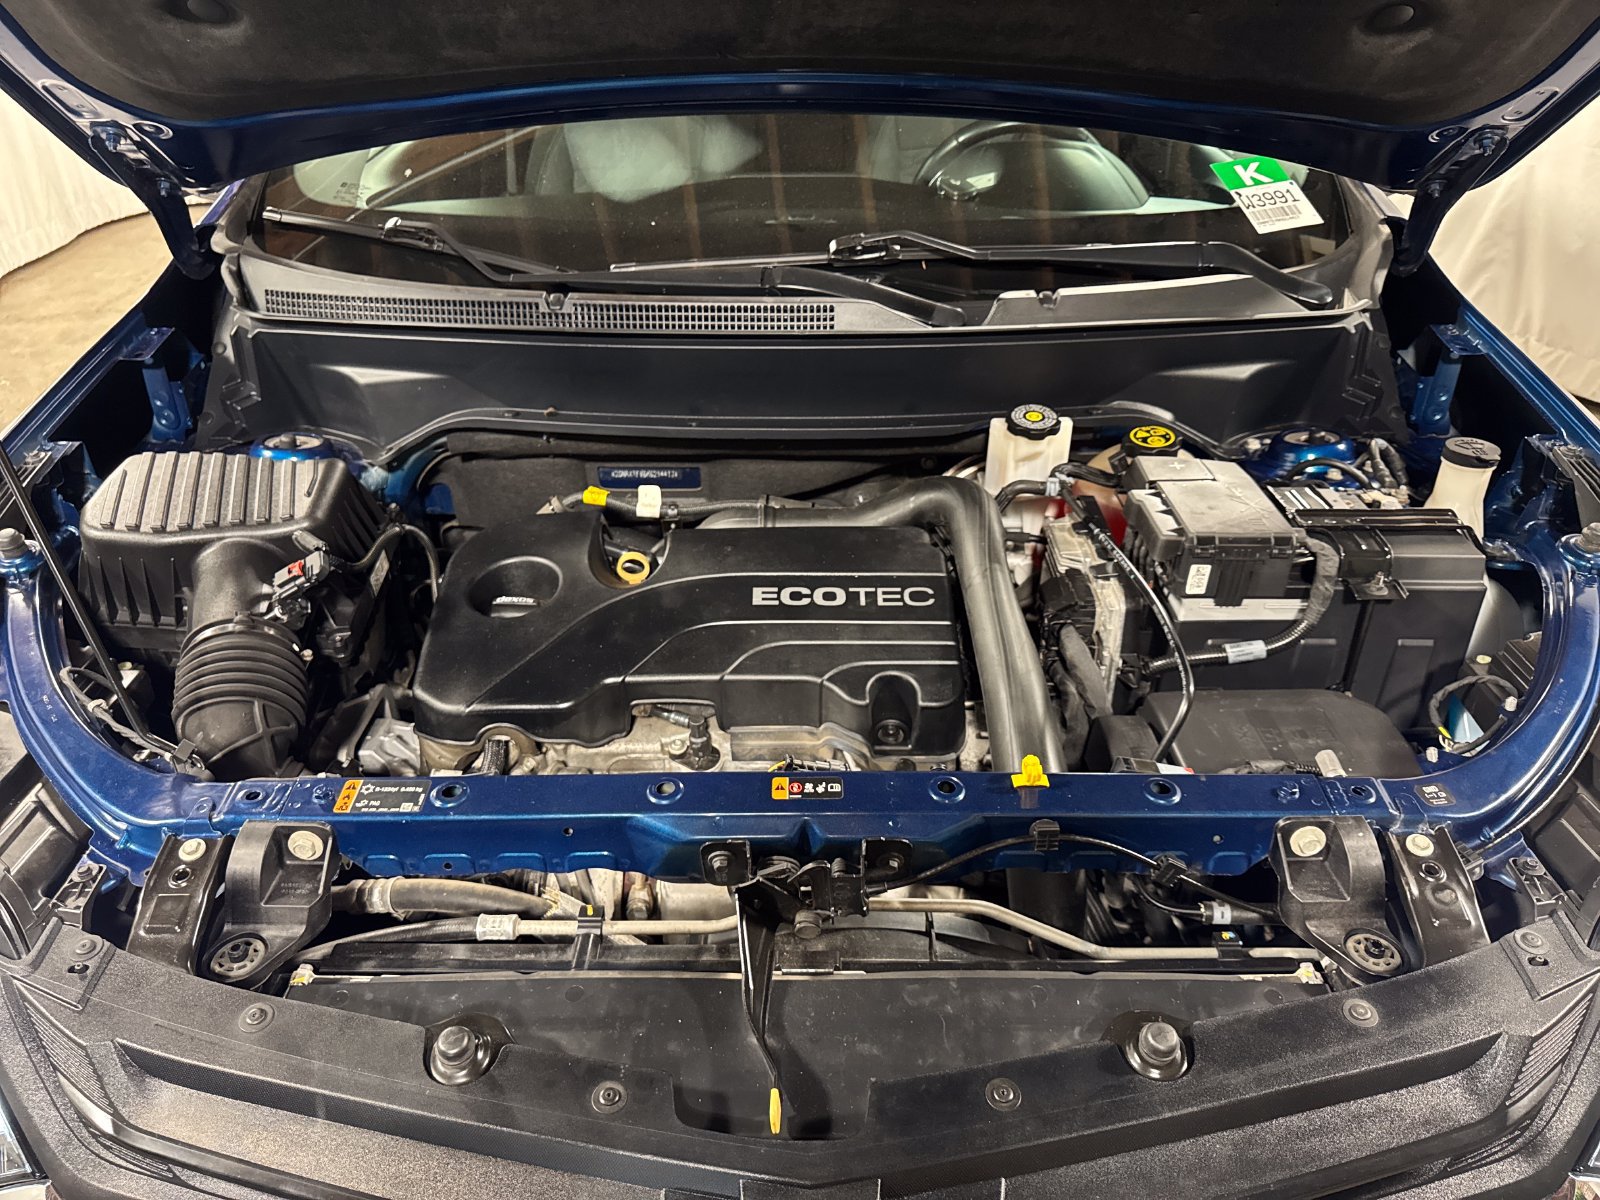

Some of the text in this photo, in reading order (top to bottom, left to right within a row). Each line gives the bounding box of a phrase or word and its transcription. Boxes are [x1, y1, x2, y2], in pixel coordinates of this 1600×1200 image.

[1233, 162, 1274, 186] K
[1239, 189, 1300, 210] W3991
[752, 587, 936, 606] ECOTEC
